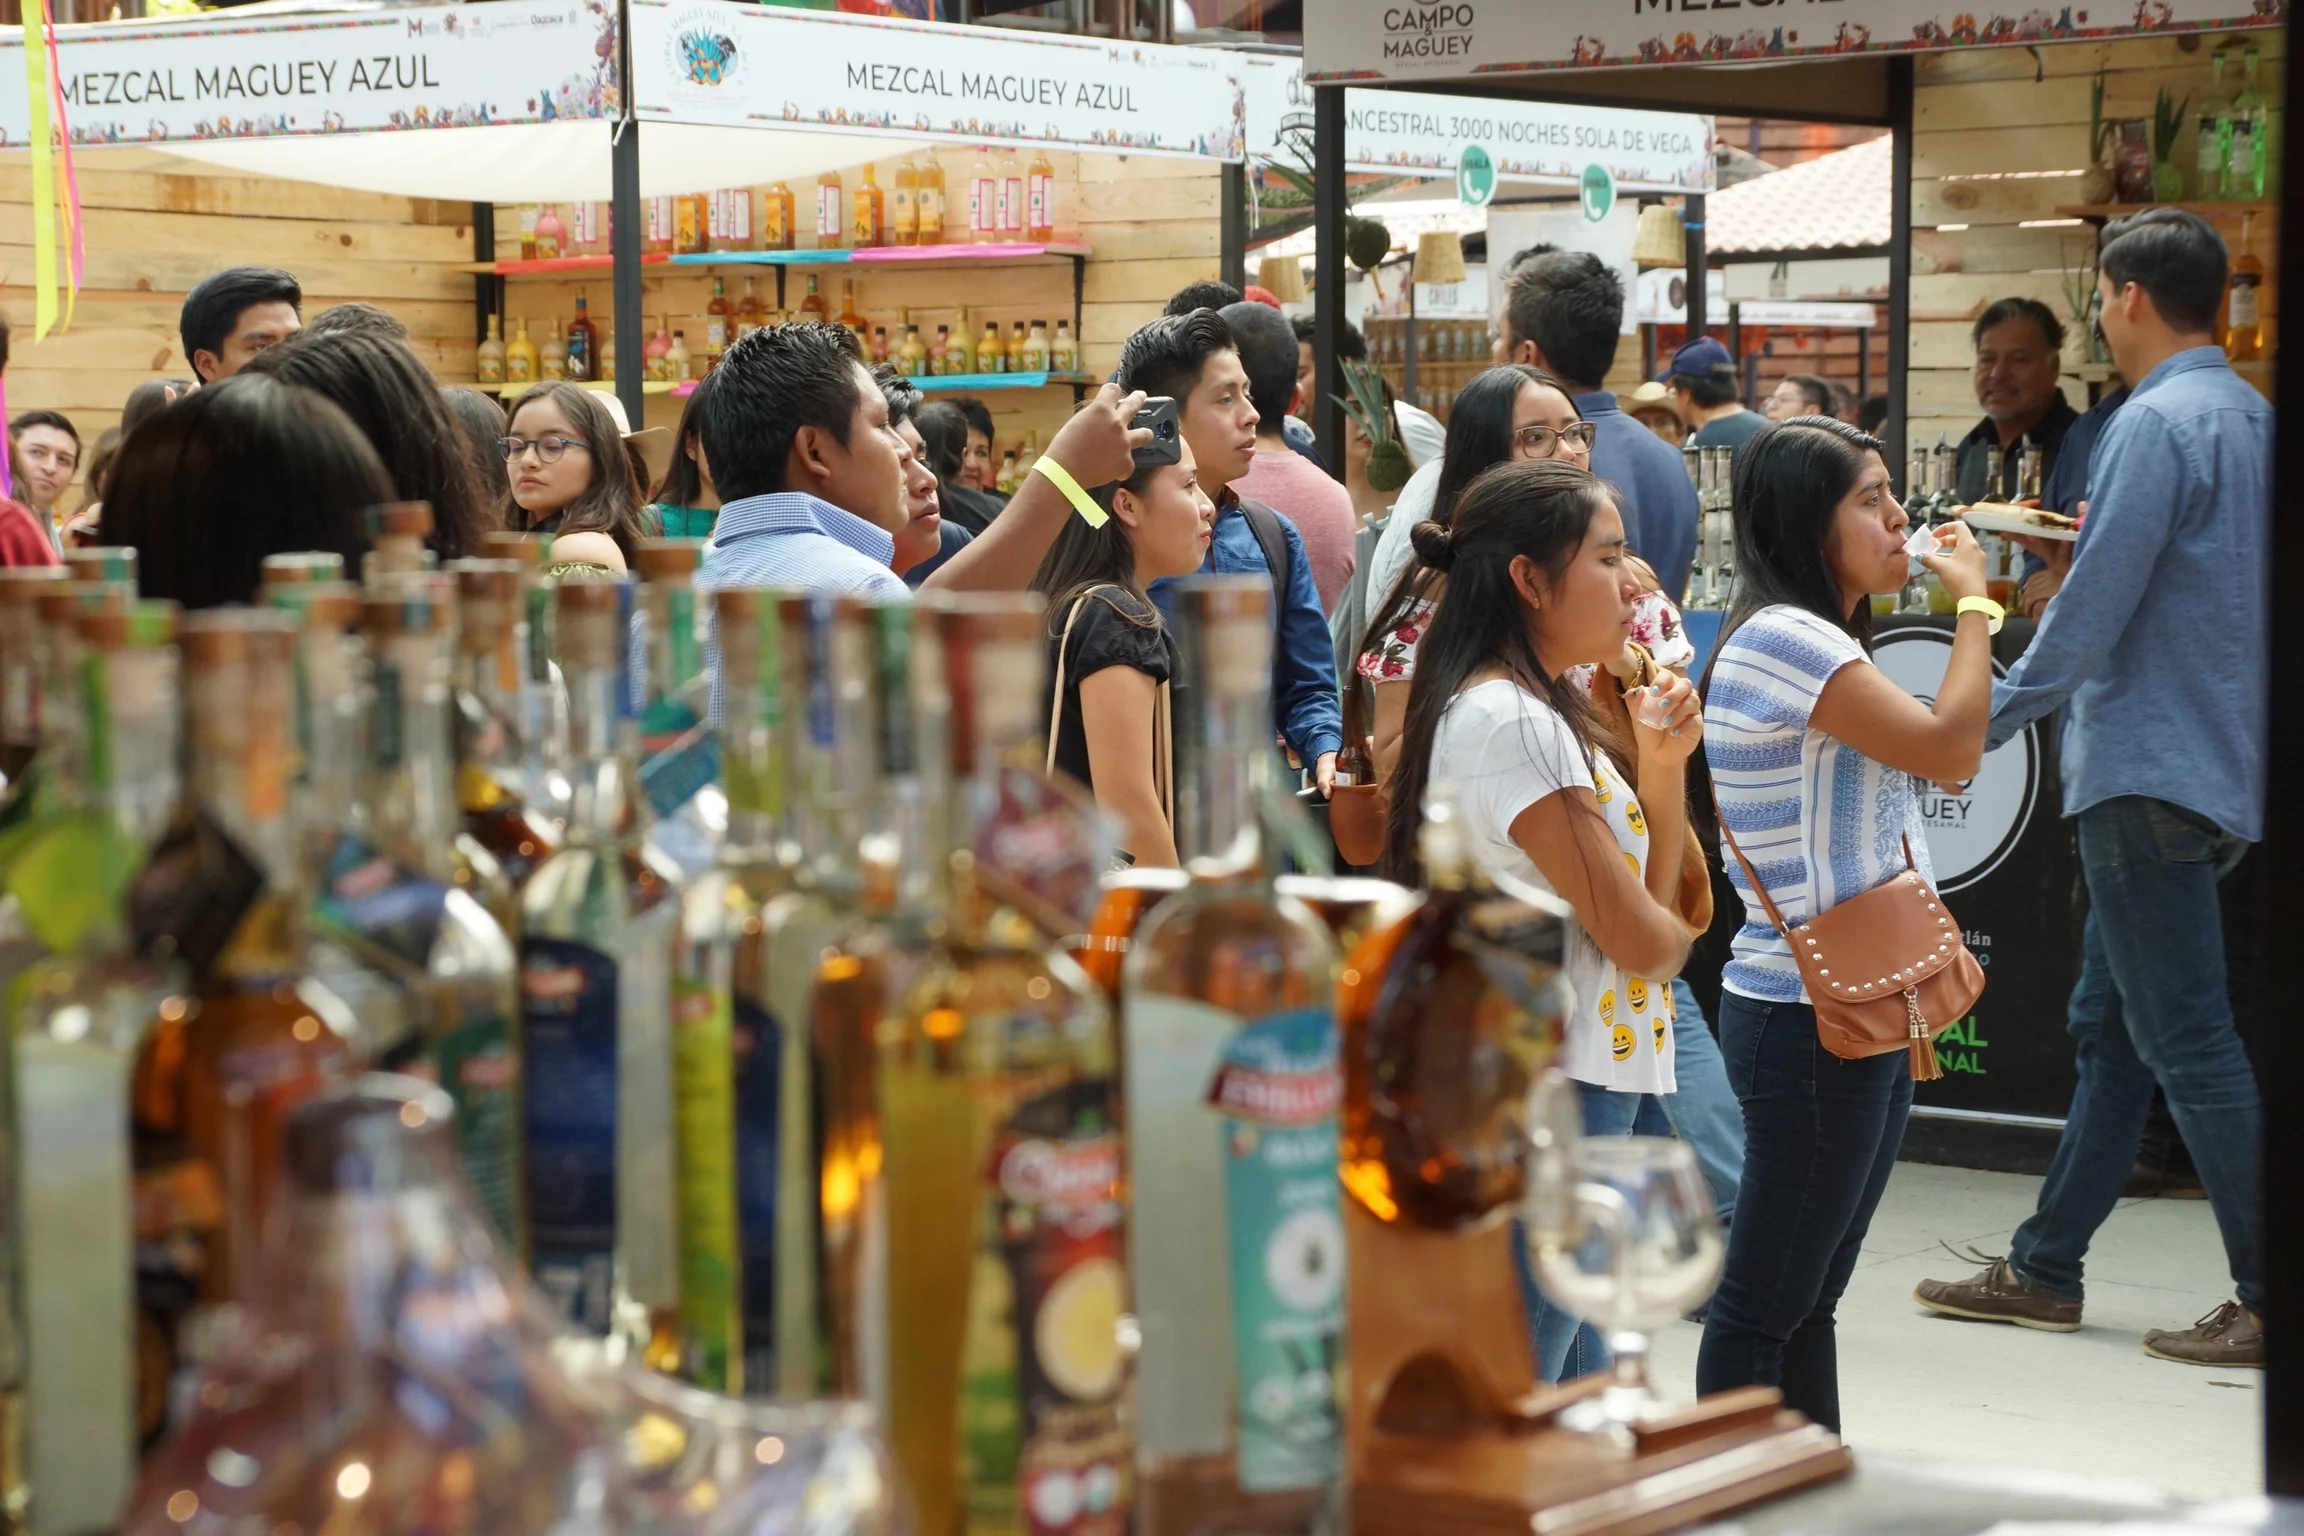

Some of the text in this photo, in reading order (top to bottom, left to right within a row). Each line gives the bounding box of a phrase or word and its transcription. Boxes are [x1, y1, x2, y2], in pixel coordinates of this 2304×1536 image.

[1384, 4, 1474, 31] CAMPO
[1424, 22, 1433, 36] &
[1384, 35, 1474, 58] MAGUEY
[195, 60, 338, 101] MAGUEY
[348, 54, 440, 92] AZUL
[847, 61, 1139, 113] MEZCAL MAGUEY AZUL
[1345, 109, 1694, 154] NCESTRAL 3000 NOCHES SOLA DE VEGA
